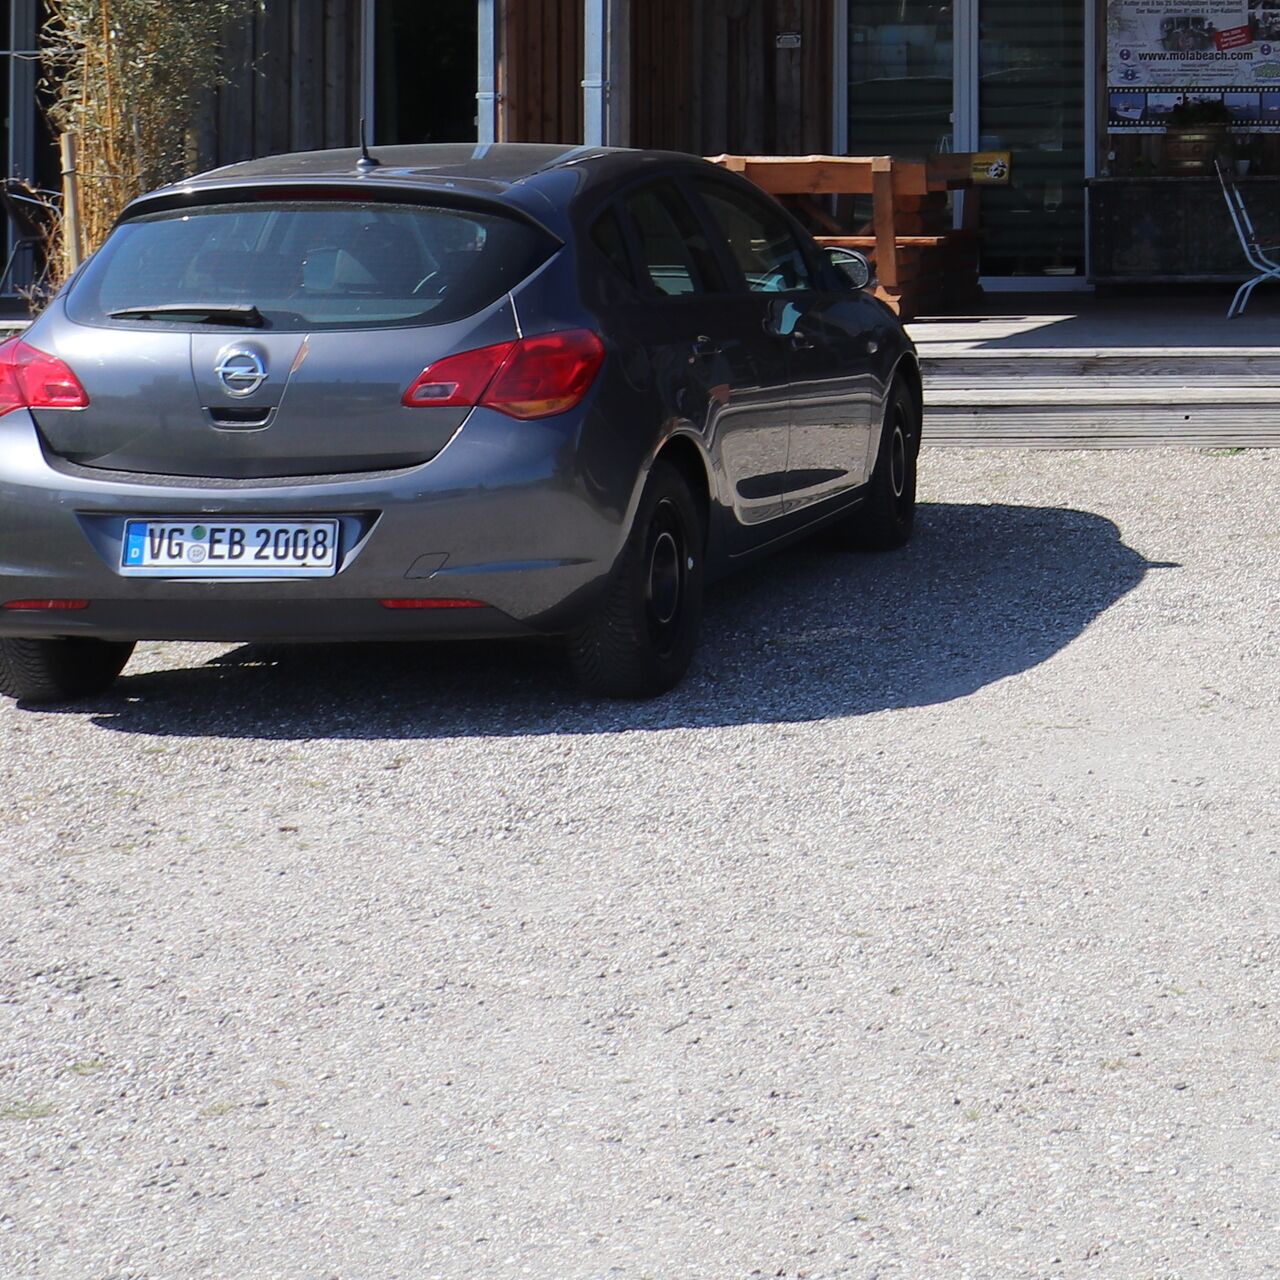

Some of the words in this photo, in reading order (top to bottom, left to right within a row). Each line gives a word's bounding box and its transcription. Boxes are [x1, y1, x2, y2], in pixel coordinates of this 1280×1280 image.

[1138, 50, 1253, 61] www.molabeach.com
[148, 528, 185, 560] VG
[208, 528, 246, 560] EB
[254, 528, 329, 561] 2008
[130, 548, 139, 558] D
